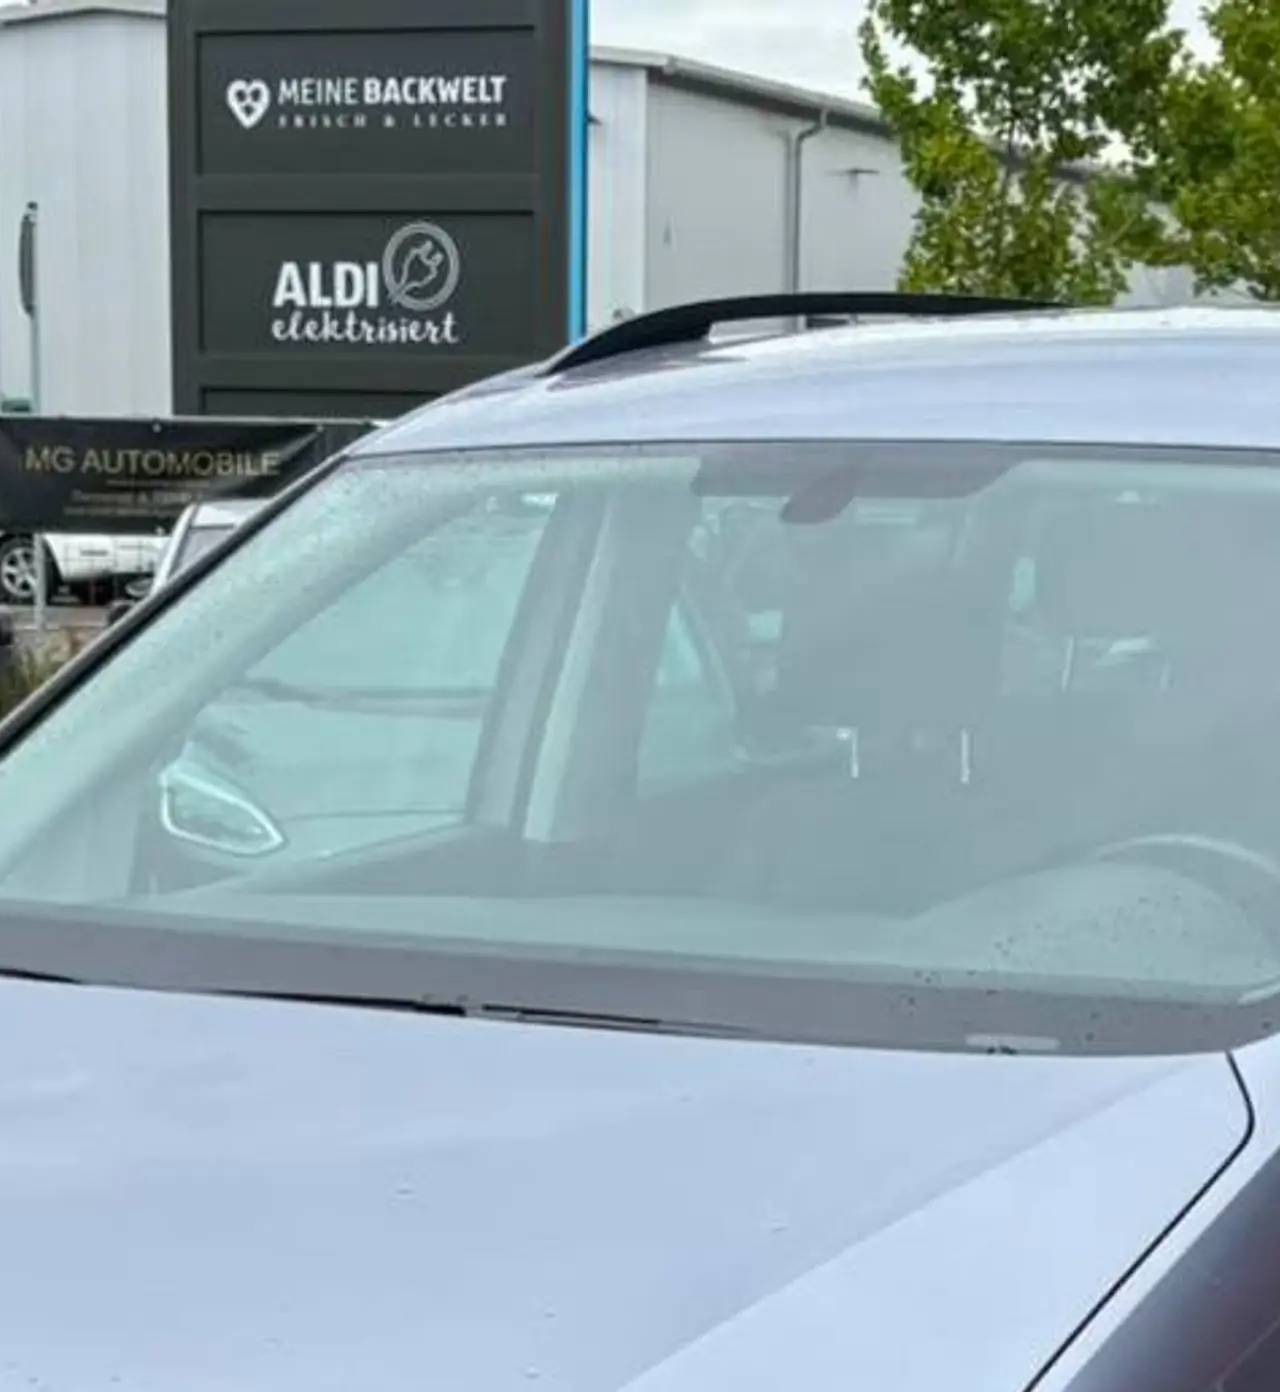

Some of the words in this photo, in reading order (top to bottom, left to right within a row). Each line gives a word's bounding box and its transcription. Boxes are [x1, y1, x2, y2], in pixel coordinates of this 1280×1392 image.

[277, 77, 359, 106] MEINE
[363, 75, 508, 105] BACKWELT
[272, 261, 379, 308] ALDI
[272, 310, 460, 344] elektrisiert
[24, 446, 75, 473] MG
[81, 448, 282, 477] AUTOMOBILE
